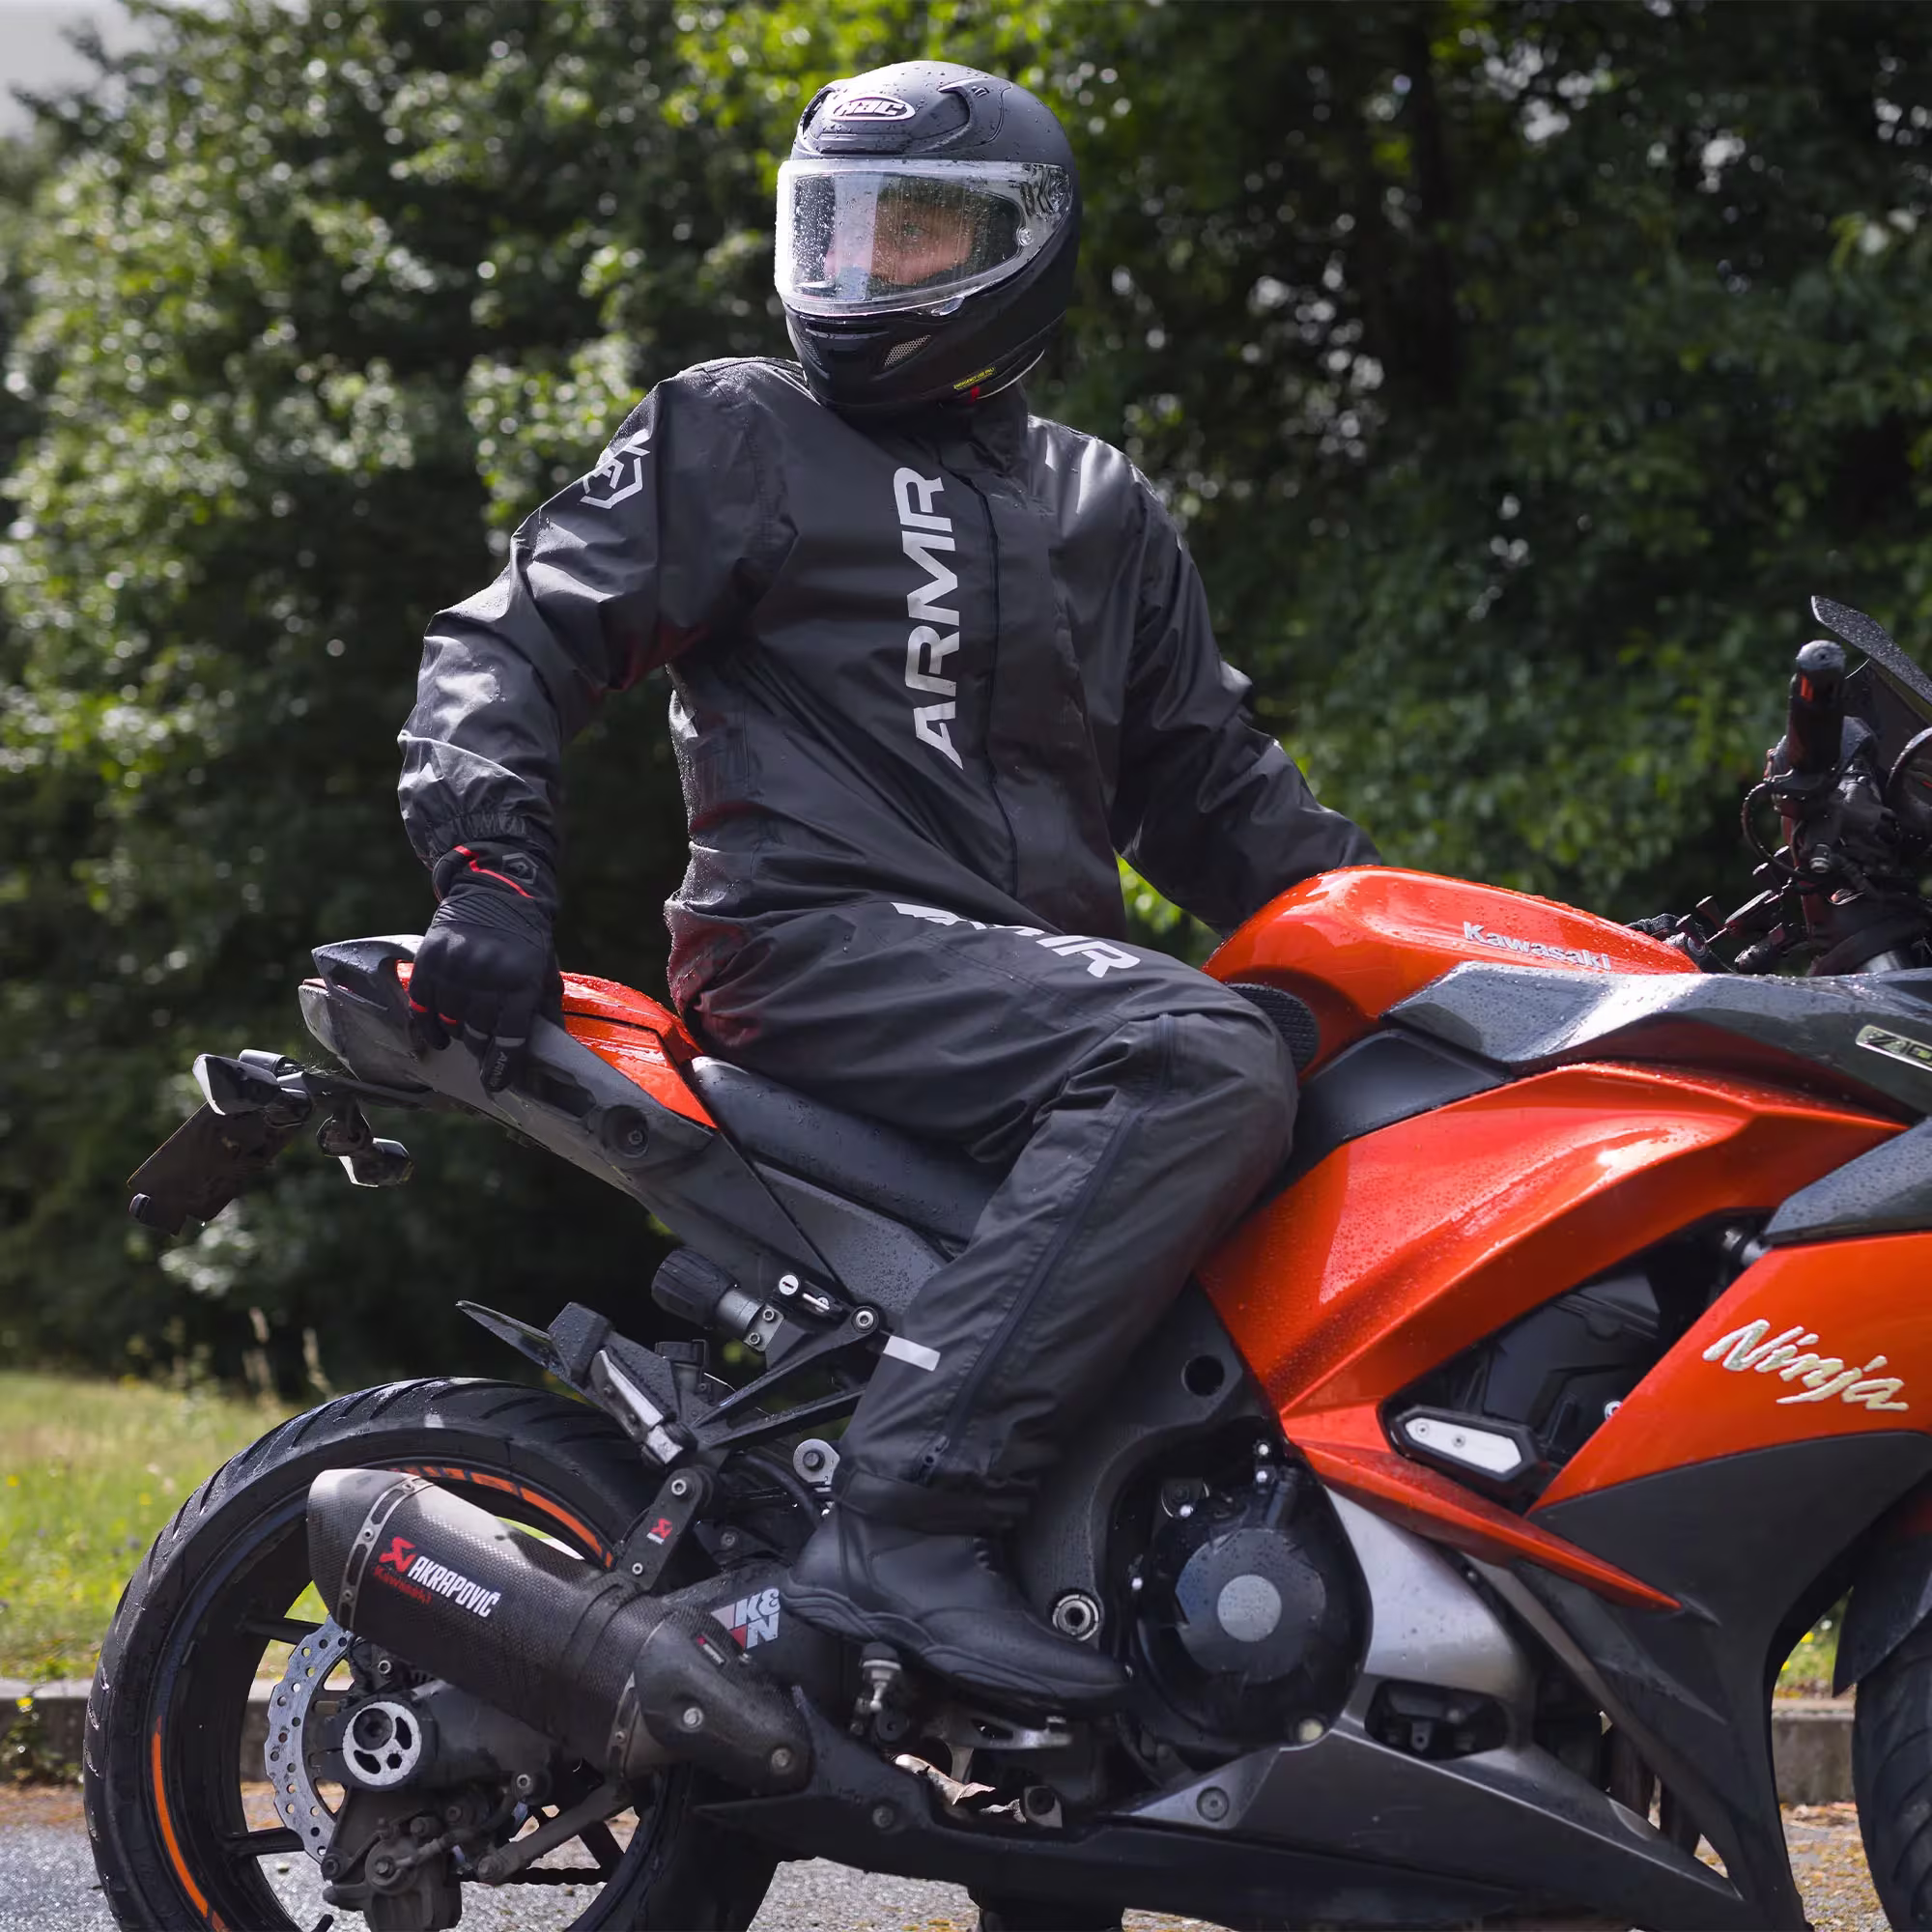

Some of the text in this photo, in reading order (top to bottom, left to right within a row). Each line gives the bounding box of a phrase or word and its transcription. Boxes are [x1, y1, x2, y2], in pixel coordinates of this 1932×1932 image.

[893, 467, 964, 770] ARMR
[1463, 921, 1611, 971] Kawasaki
[1702, 1319, 1909, 1410] Ninja
